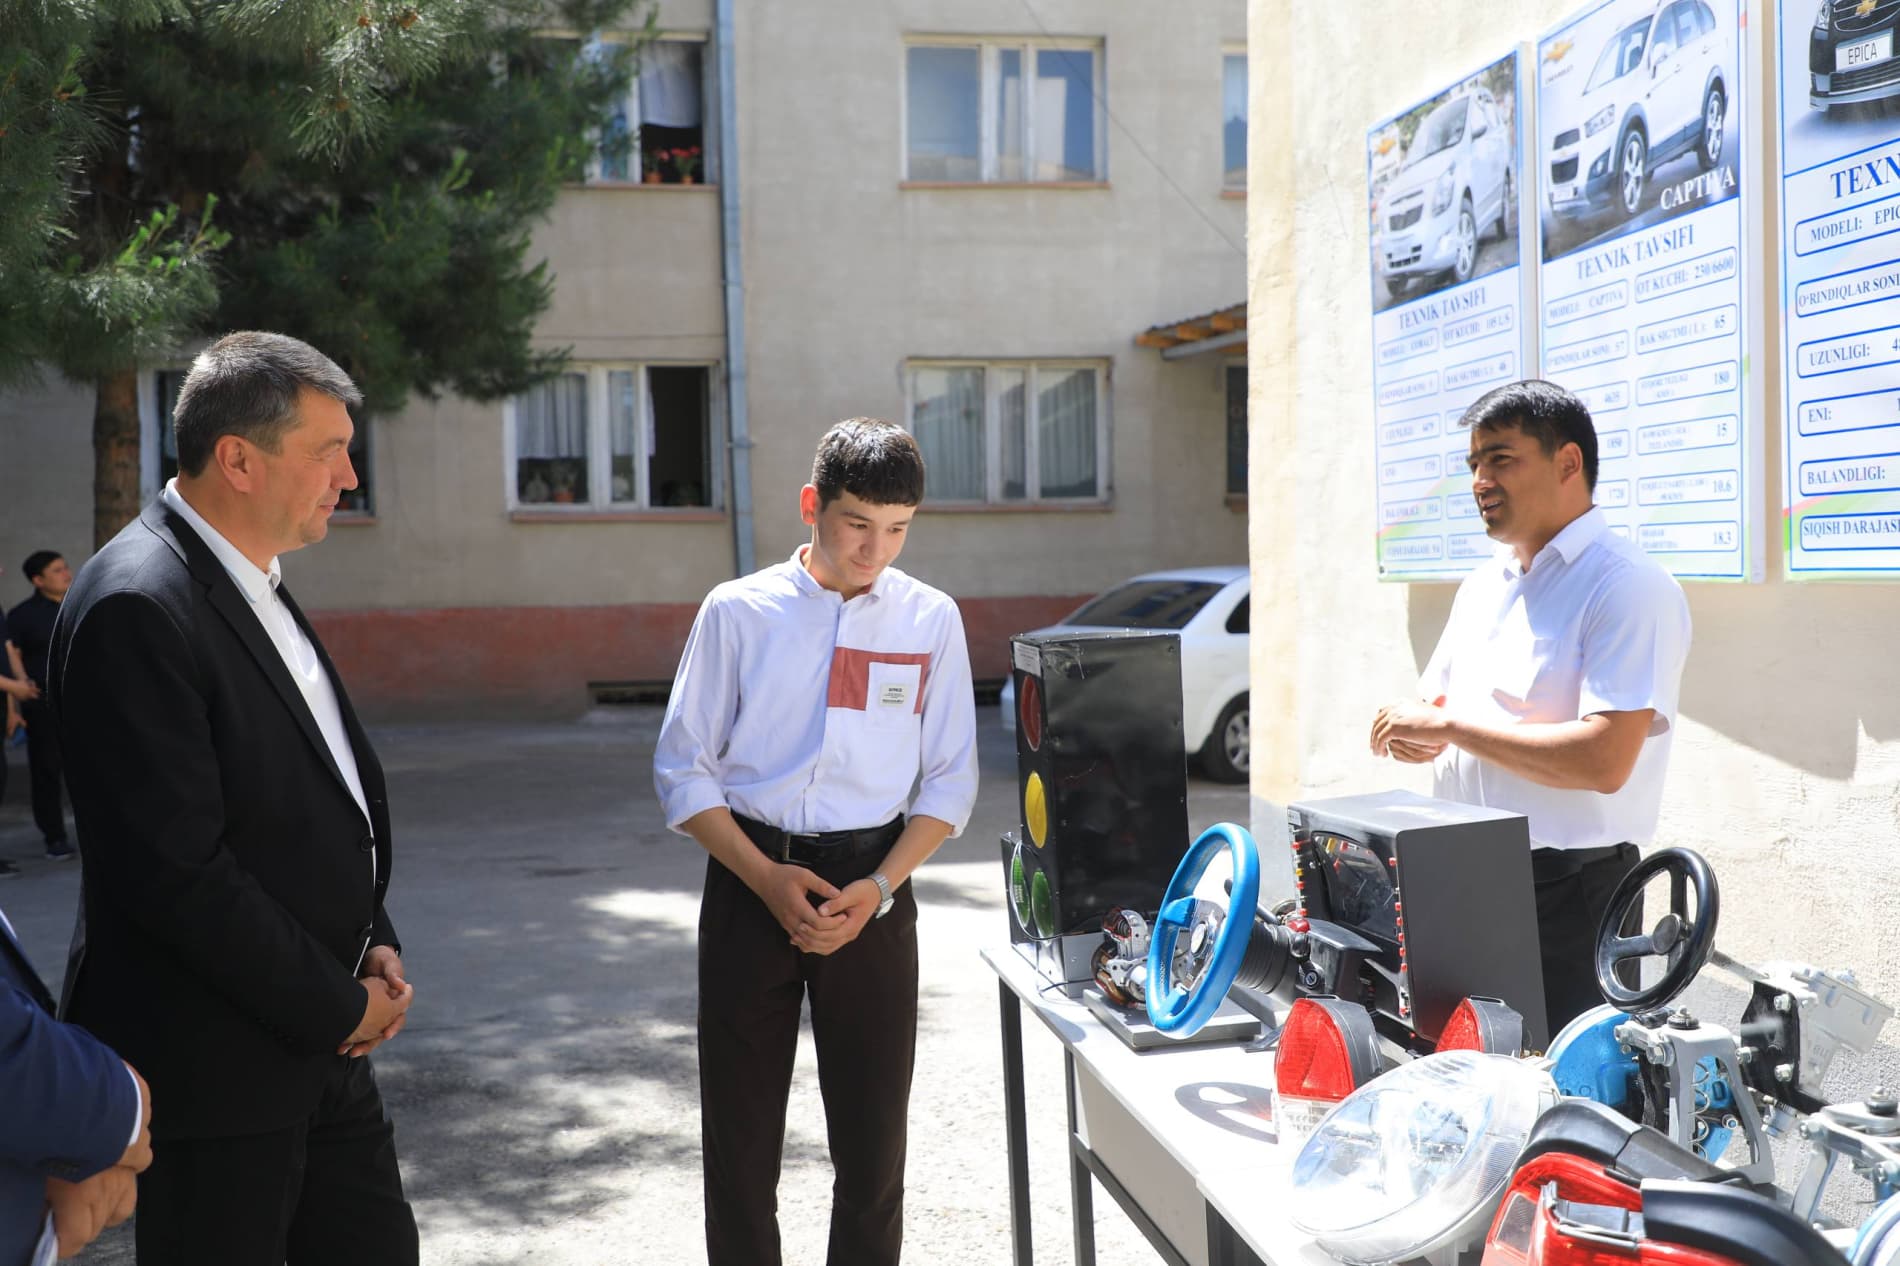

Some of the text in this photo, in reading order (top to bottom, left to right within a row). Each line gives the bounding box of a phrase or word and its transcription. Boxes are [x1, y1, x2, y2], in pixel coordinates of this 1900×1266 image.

[1848, 43, 1878, 65] EPICA
[1660, 165, 1736, 210] CAPTIVA
[1811, 217, 1863, 243] MODELI:
[1576, 224, 1694, 280] TEXNIK TAVSIFI
[1810, 343, 1870, 366] UZUNLIGI:
[1808, 407, 1832, 423] ENI:
[1807, 466, 1886, 485] BALANDLIGI:
[1803, 520, 1840, 538] SIQISH
